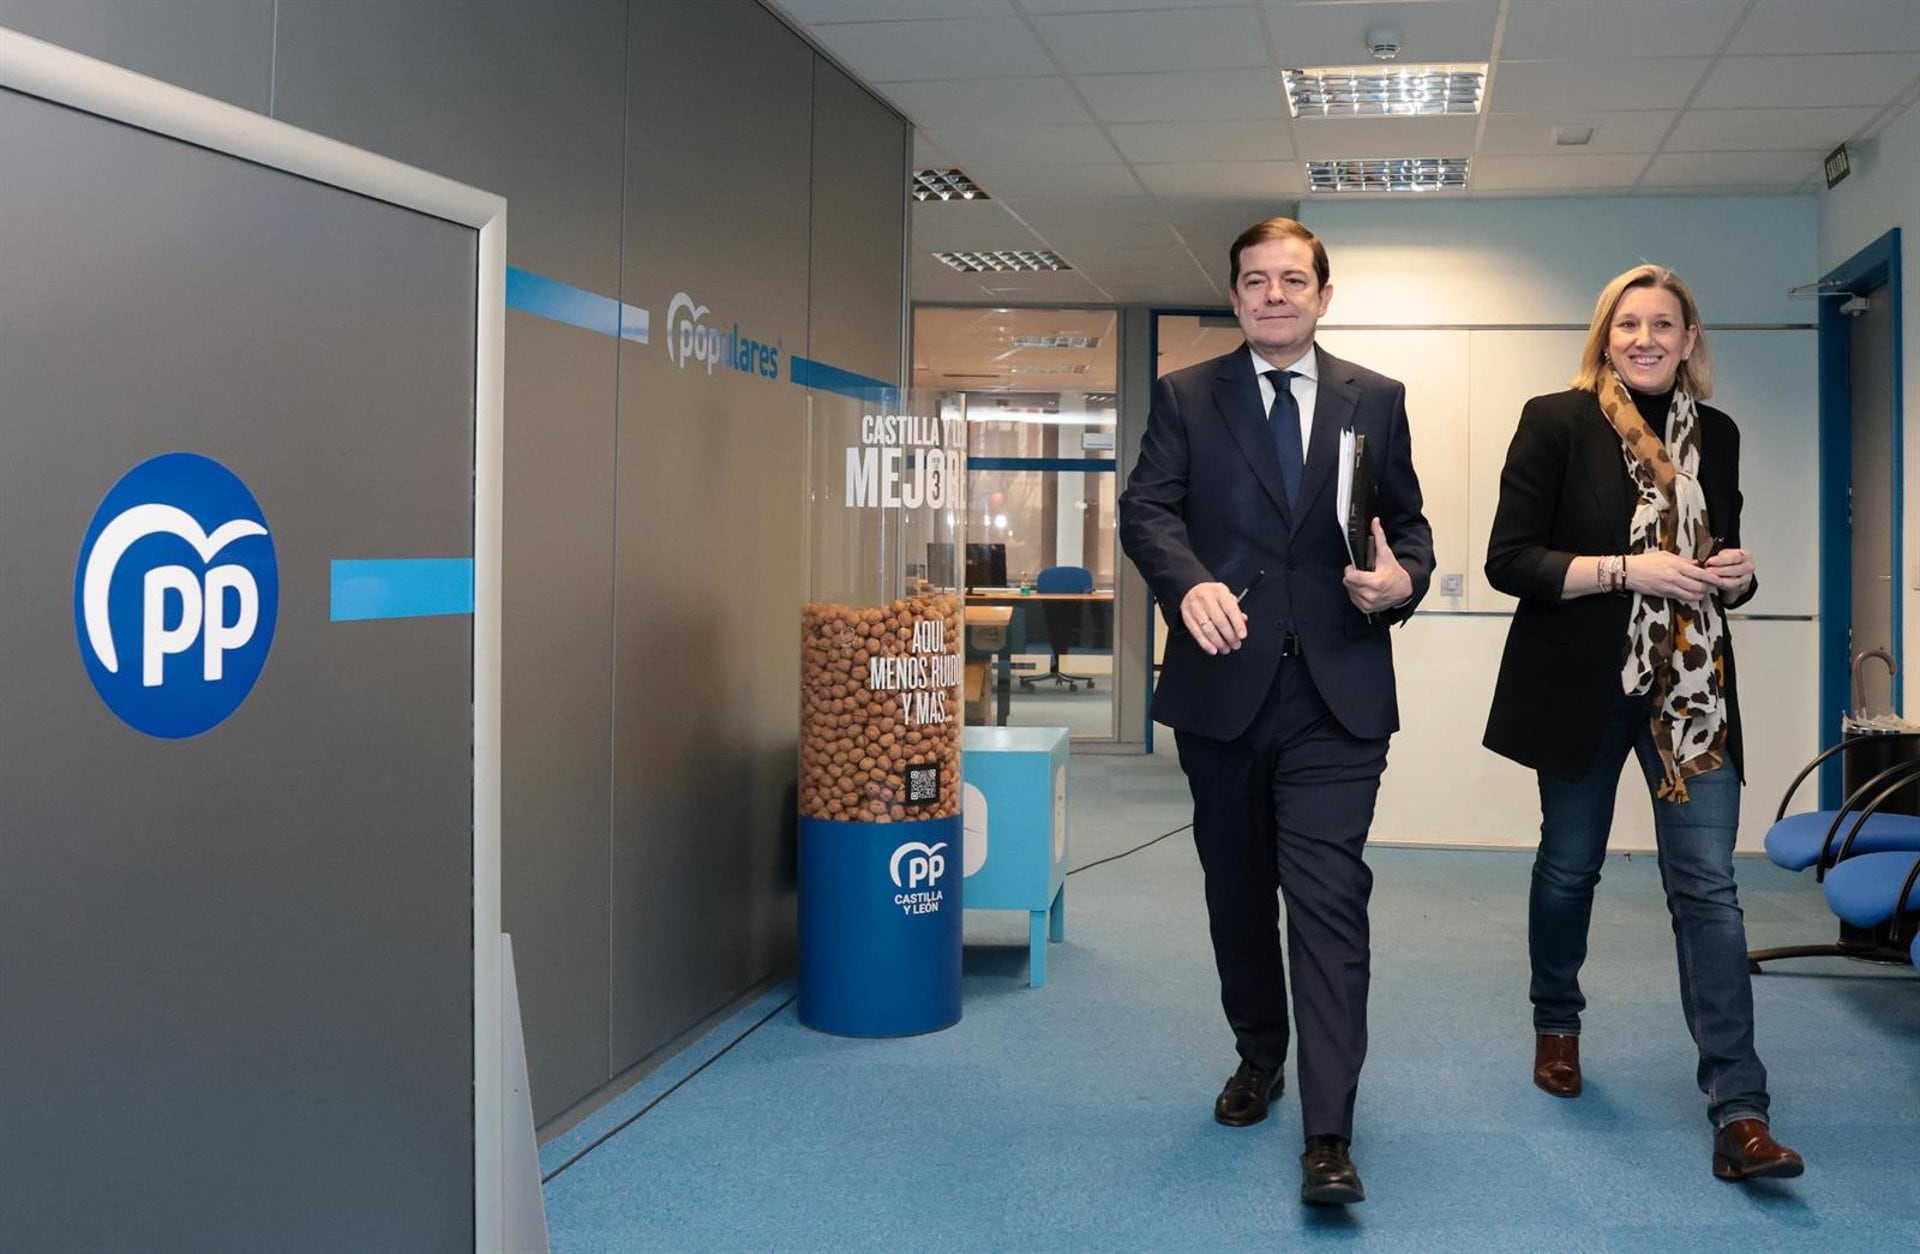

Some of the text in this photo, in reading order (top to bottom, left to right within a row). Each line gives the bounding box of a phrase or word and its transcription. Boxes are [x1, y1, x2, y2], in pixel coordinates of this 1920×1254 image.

[680, 319, 778, 379] populares
[862, 415, 939, 446] CASTILLA
[870, 656, 928, 690] MENOS
[902, 692, 912, 725] Y
[895, 891, 943, 904] CASTILLA
[903, 901, 939, 915] Y LEÓN
